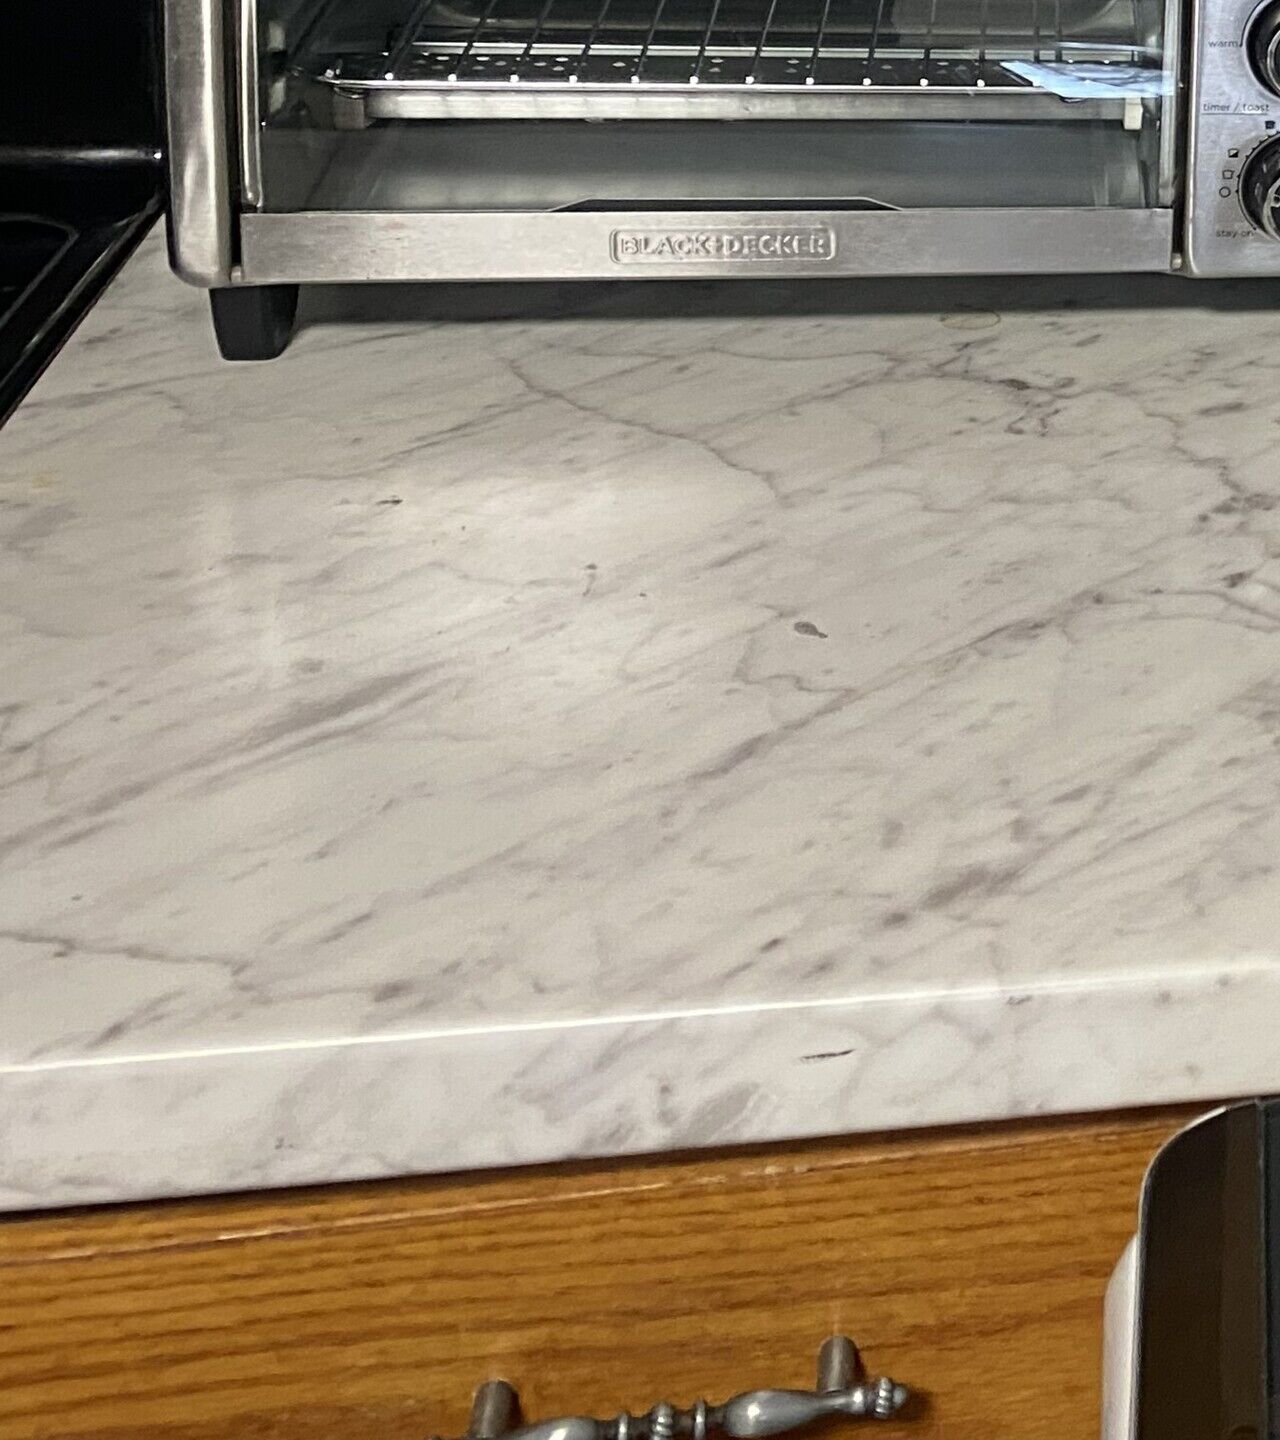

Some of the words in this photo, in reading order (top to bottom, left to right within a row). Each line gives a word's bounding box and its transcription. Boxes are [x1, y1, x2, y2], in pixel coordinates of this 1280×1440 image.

[1208, 40, 1238, 48] warm
[1203, 103, 1231, 111] timer
[1242, 102, 1270, 112] toast
[1216, 230, 1238, 239] stay
